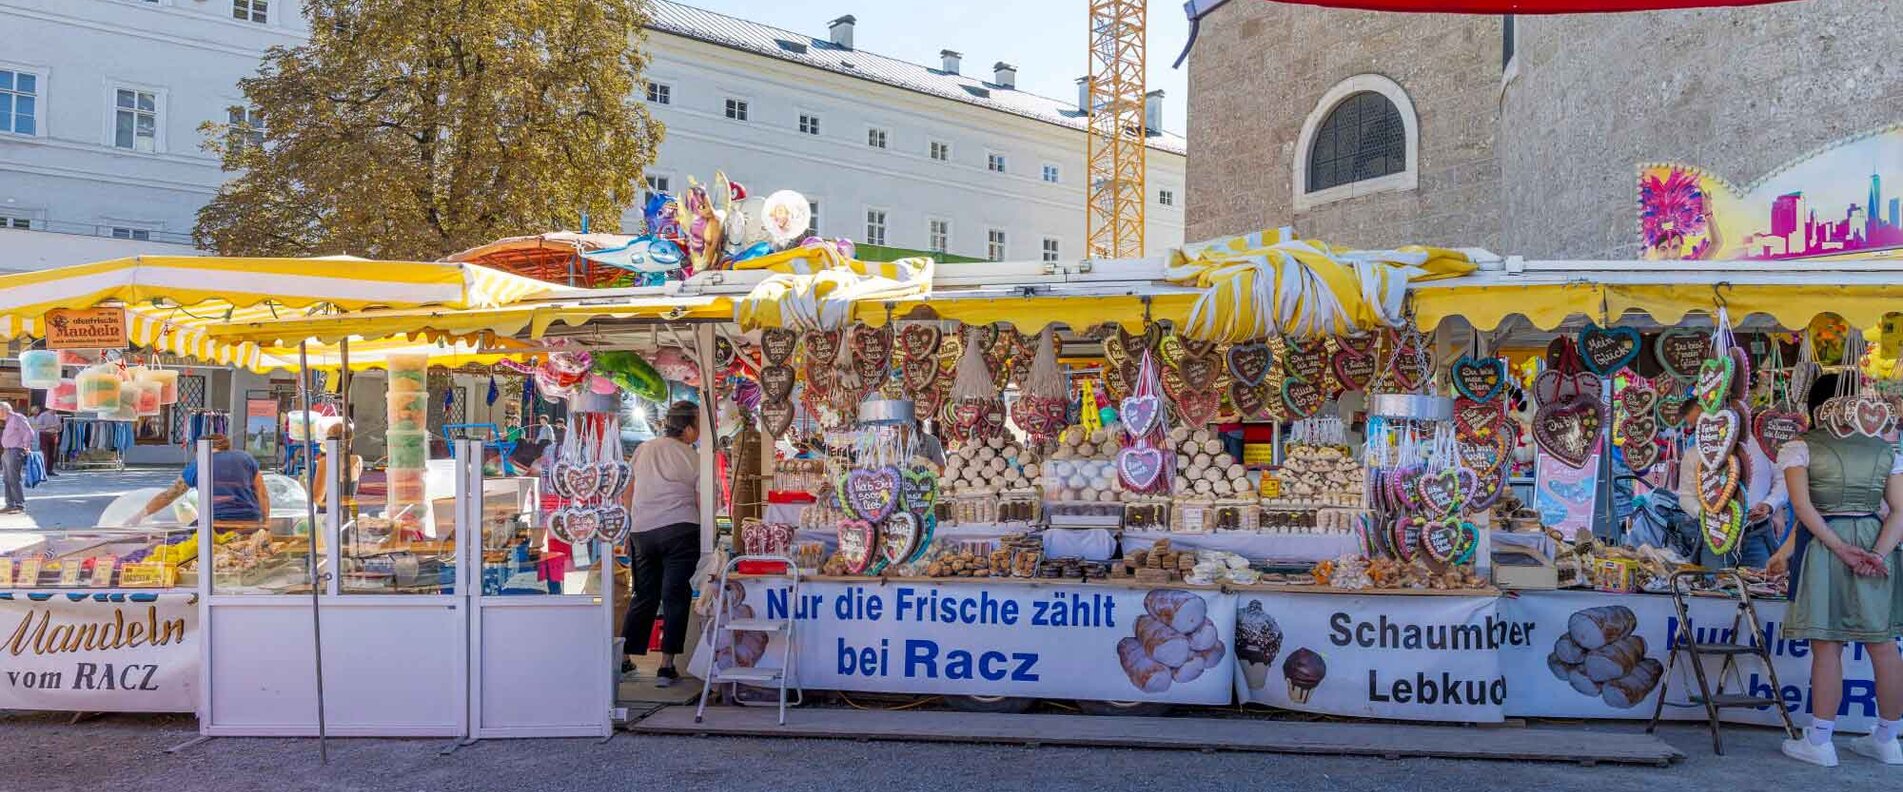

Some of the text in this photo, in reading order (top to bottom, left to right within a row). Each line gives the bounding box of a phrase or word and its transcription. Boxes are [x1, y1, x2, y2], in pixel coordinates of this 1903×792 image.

[1588, 338, 1615, 351] Mein
[1594, 347, 1630, 366] Glück
[854, 478, 873, 491] Hab
[766, 588, 1115, 627] Nur die Frische zählt
[0, 605, 185, 656] Mandeln
[1666, 616, 1734, 651] Nur
[837, 637, 1040, 682] bei Racz
[7, 662, 160, 691] vom RACZ
